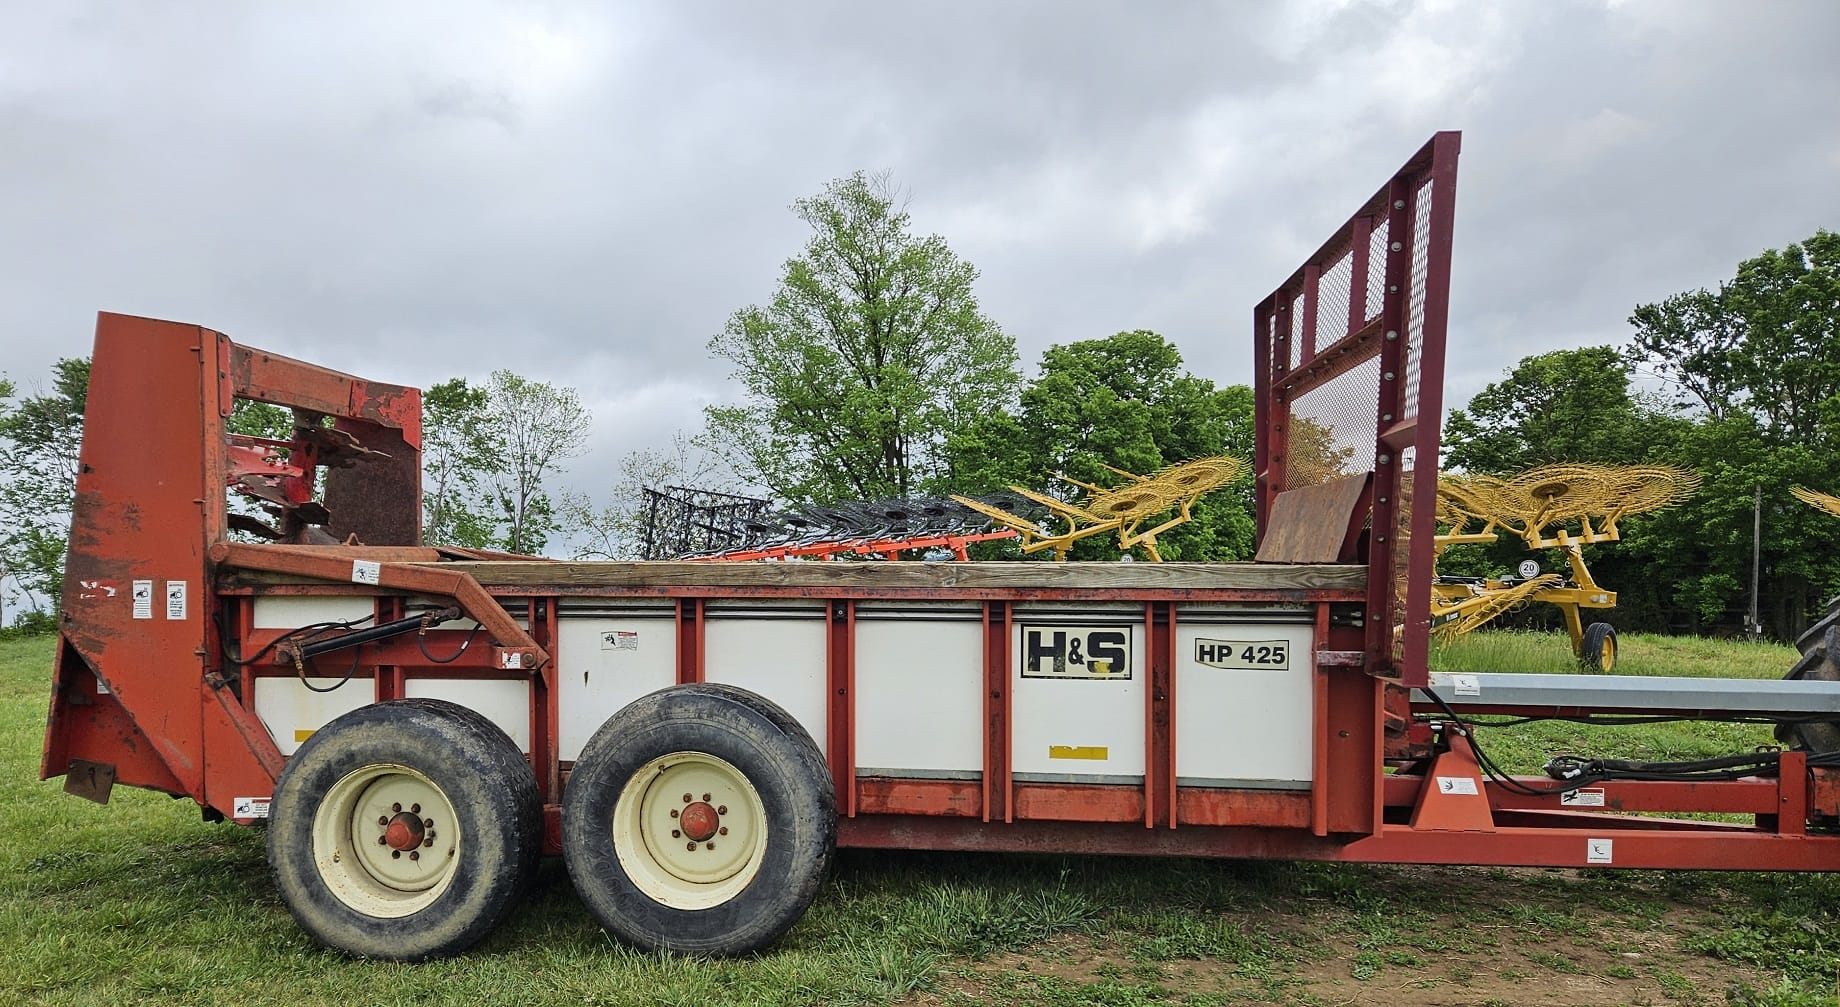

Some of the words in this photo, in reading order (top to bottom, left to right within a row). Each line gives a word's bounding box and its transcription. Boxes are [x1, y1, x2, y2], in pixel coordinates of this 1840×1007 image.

[1523, 563, 1535, 571] 20
[1028, 631, 1126, 673] H&S
[1199, 645, 1232, 662] HP
[1241, 646, 1286, 664] 425
